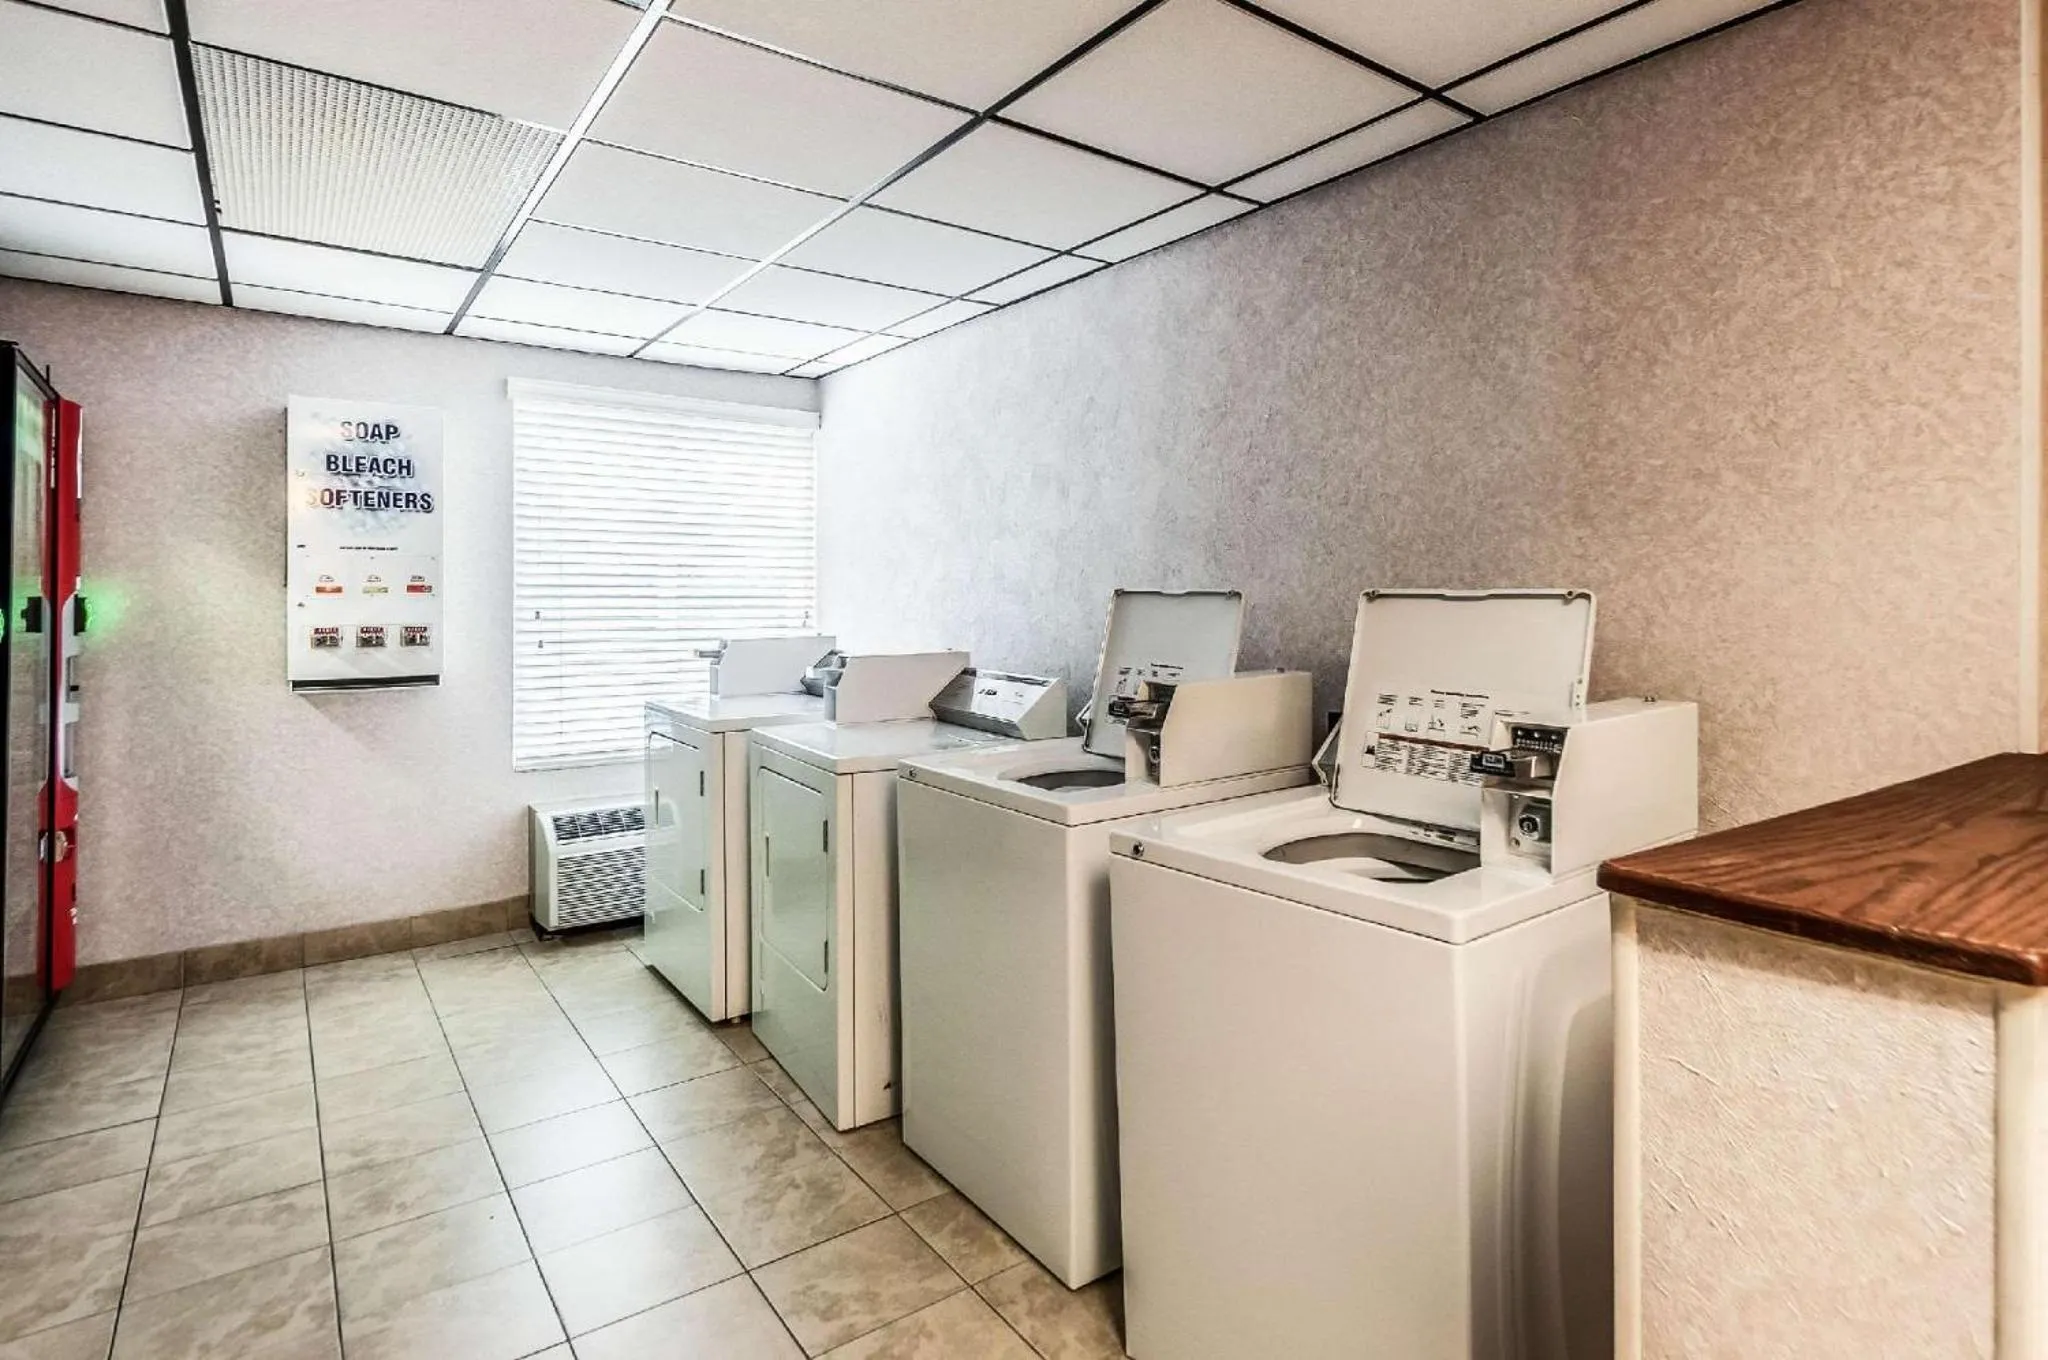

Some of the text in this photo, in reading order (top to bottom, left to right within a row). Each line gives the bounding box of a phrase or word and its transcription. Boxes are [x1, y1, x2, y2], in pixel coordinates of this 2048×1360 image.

[340, 421, 401, 443] SOAP
[325, 454, 415, 478] BLEACH
[306, 487, 434, 513] SOFTENERS
